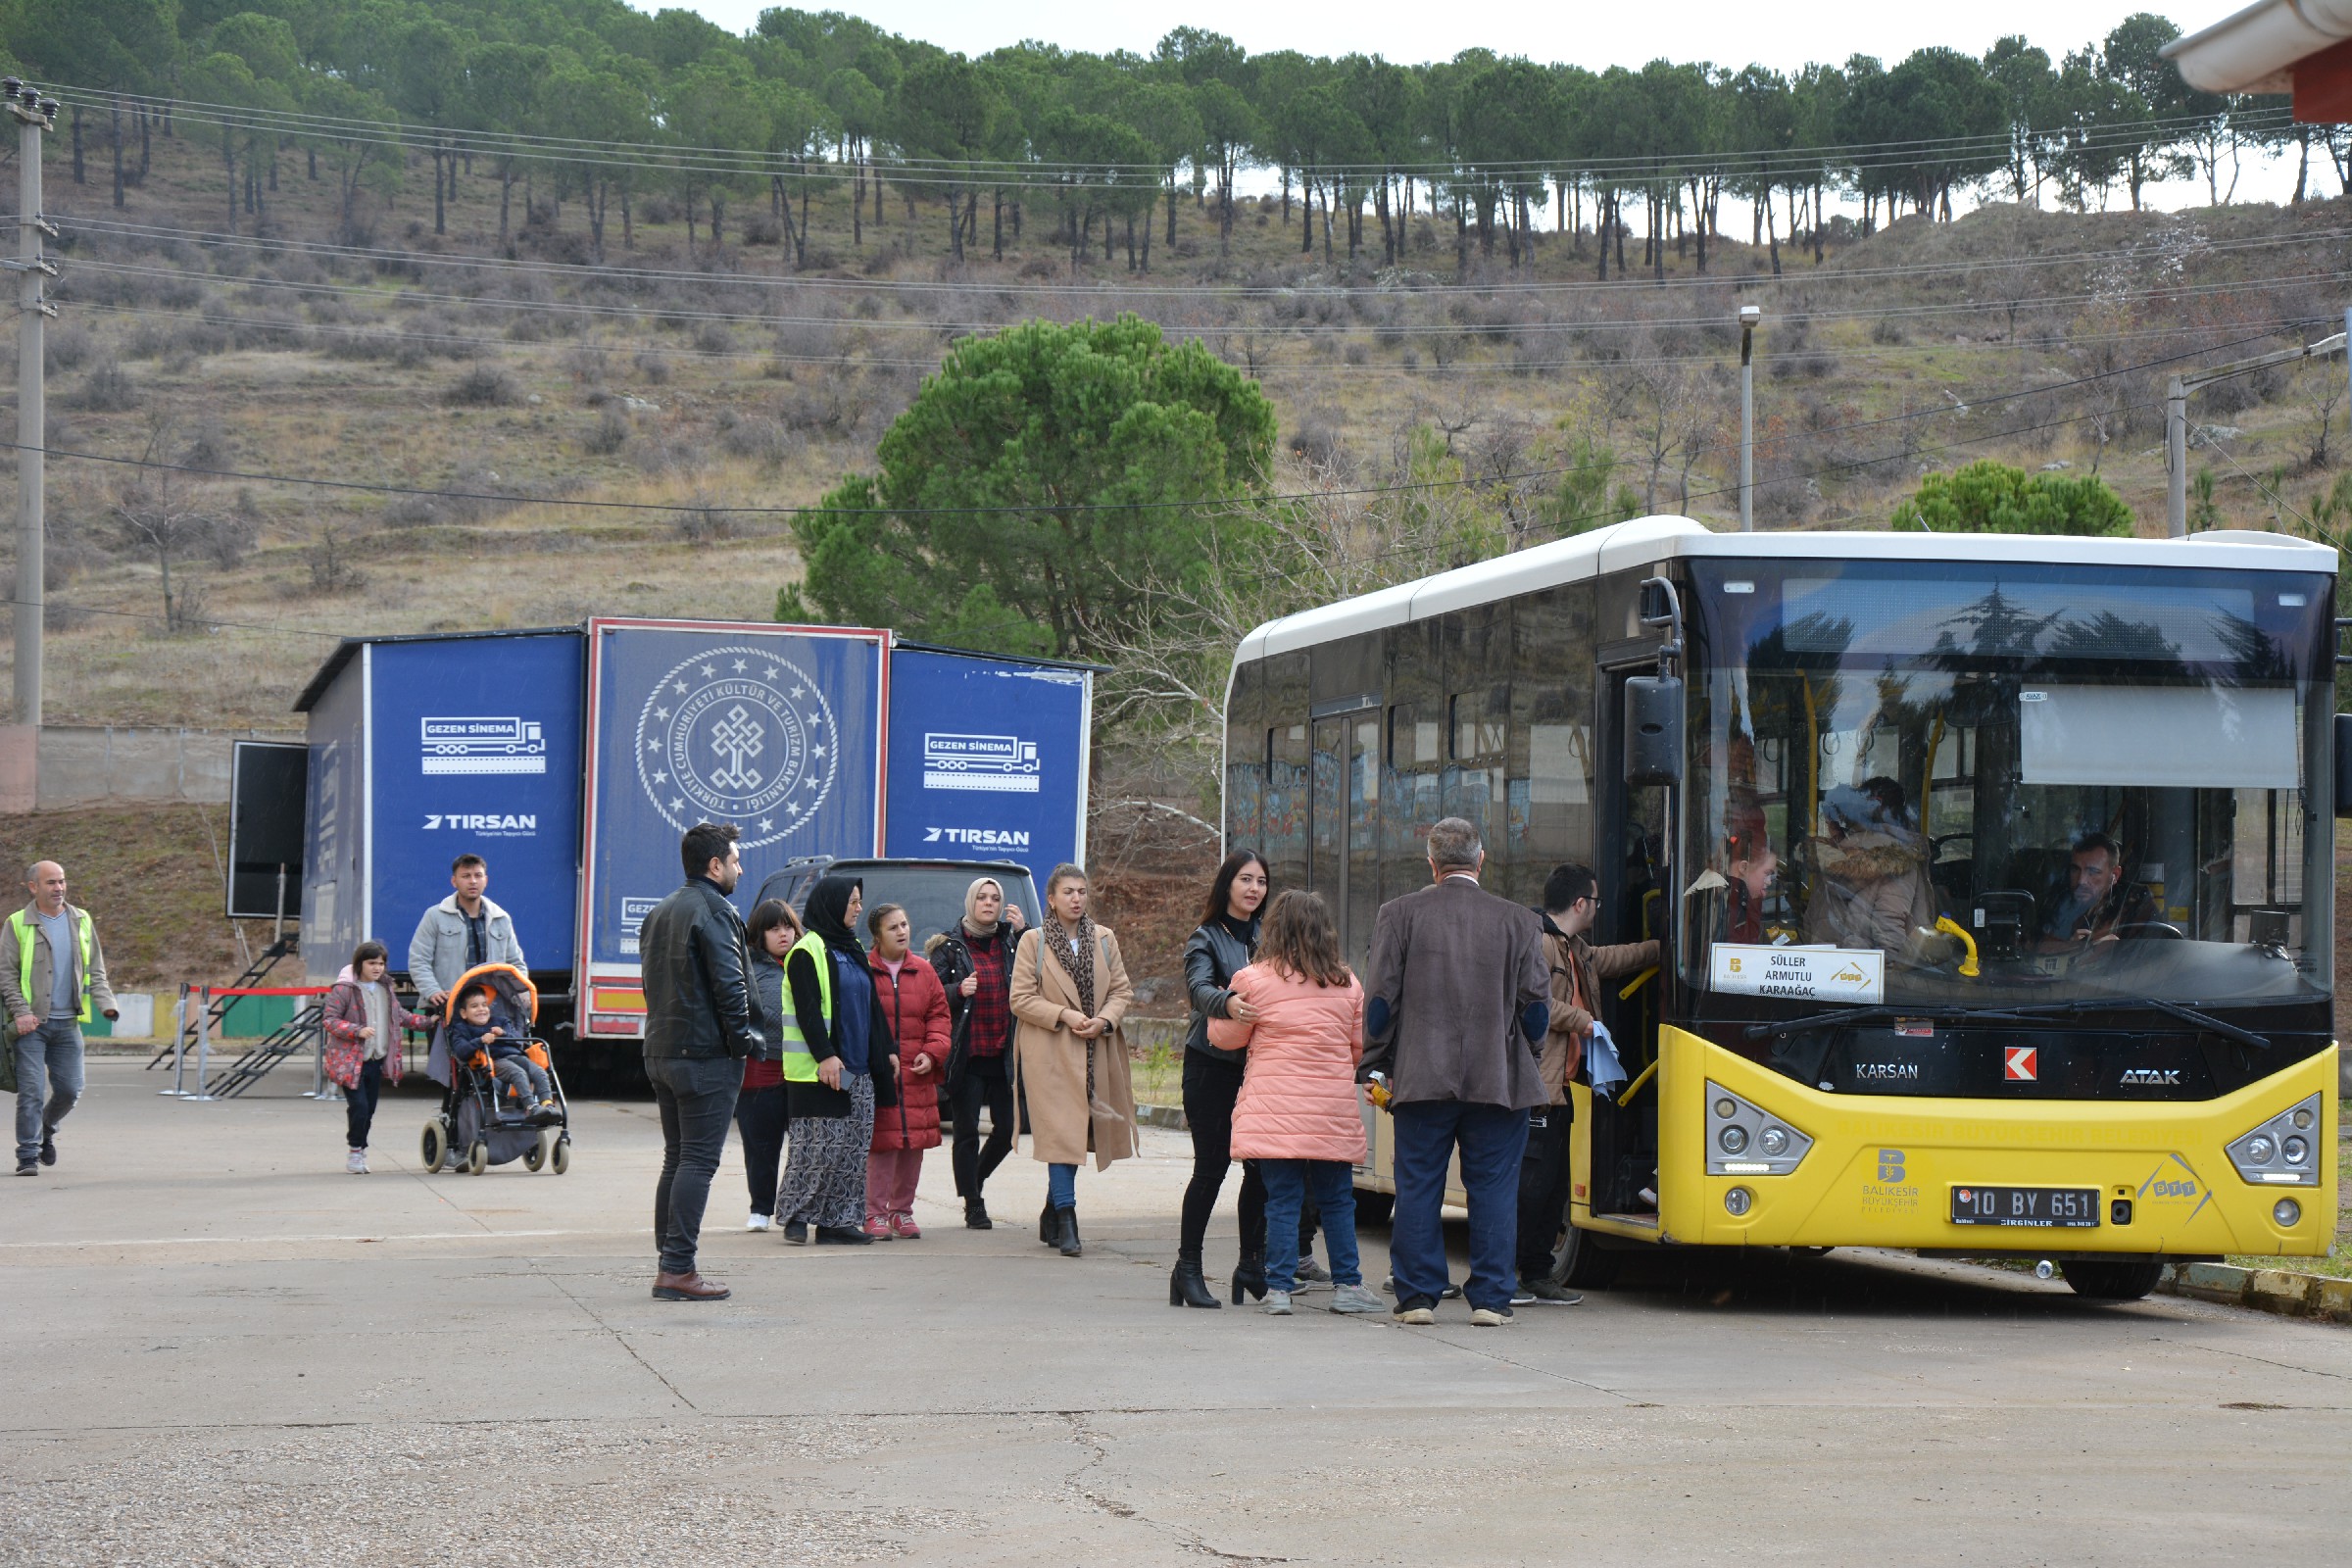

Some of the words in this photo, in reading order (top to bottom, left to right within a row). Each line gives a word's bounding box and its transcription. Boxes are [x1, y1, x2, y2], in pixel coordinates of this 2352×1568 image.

[716, 683, 765, 700] KÜLTÜR
[767, 695, 783, 710] VE
[426, 724, 466, 733] GEZEN
[468, 723, 514, 733] SİNEMA
[674, 689, 714, 769] CUMHURİYETİ
[780, 709, 801, 757] TURİZM
[930, 741, 966, 750] GEZEN
[968, 741, 1012, 752] SİNEMA
[681, 770, 725, 809] TÜRKİYE
[746, 760, 799, 810] BAKANLIĞI
[445, 814, 536, 829] TIRSAN
[945, 828, 1030, 845] TIRSAN
[1770, 955, 1806, 967] SÜLLER
[1765, 969, 1812, 982] ARMUTLU
[1856, 1064, 1918, 1078] KARSAN
[2120, 1069, 2180, 1084] ATAK
[1837, 1119, 1945, 1138] BALIKESİR
[1952, 1120, 2084, 1144] BÜYÜKŞEHİR
[2090, 1127, 2203, 1146] BELEDİYESİ
[1863, 1185, 1919, 1197] BALIKESİR
[2156, 1183, 2194, 1195] BTT
[1862, 1196, 1918, 1207] BÜYÜKŞEHİR
[1972, 1191, 1995, 1215] 10
[2012, 1191, 2037, 1215] BY
[2051, 1193, 2088, 1217] 651
